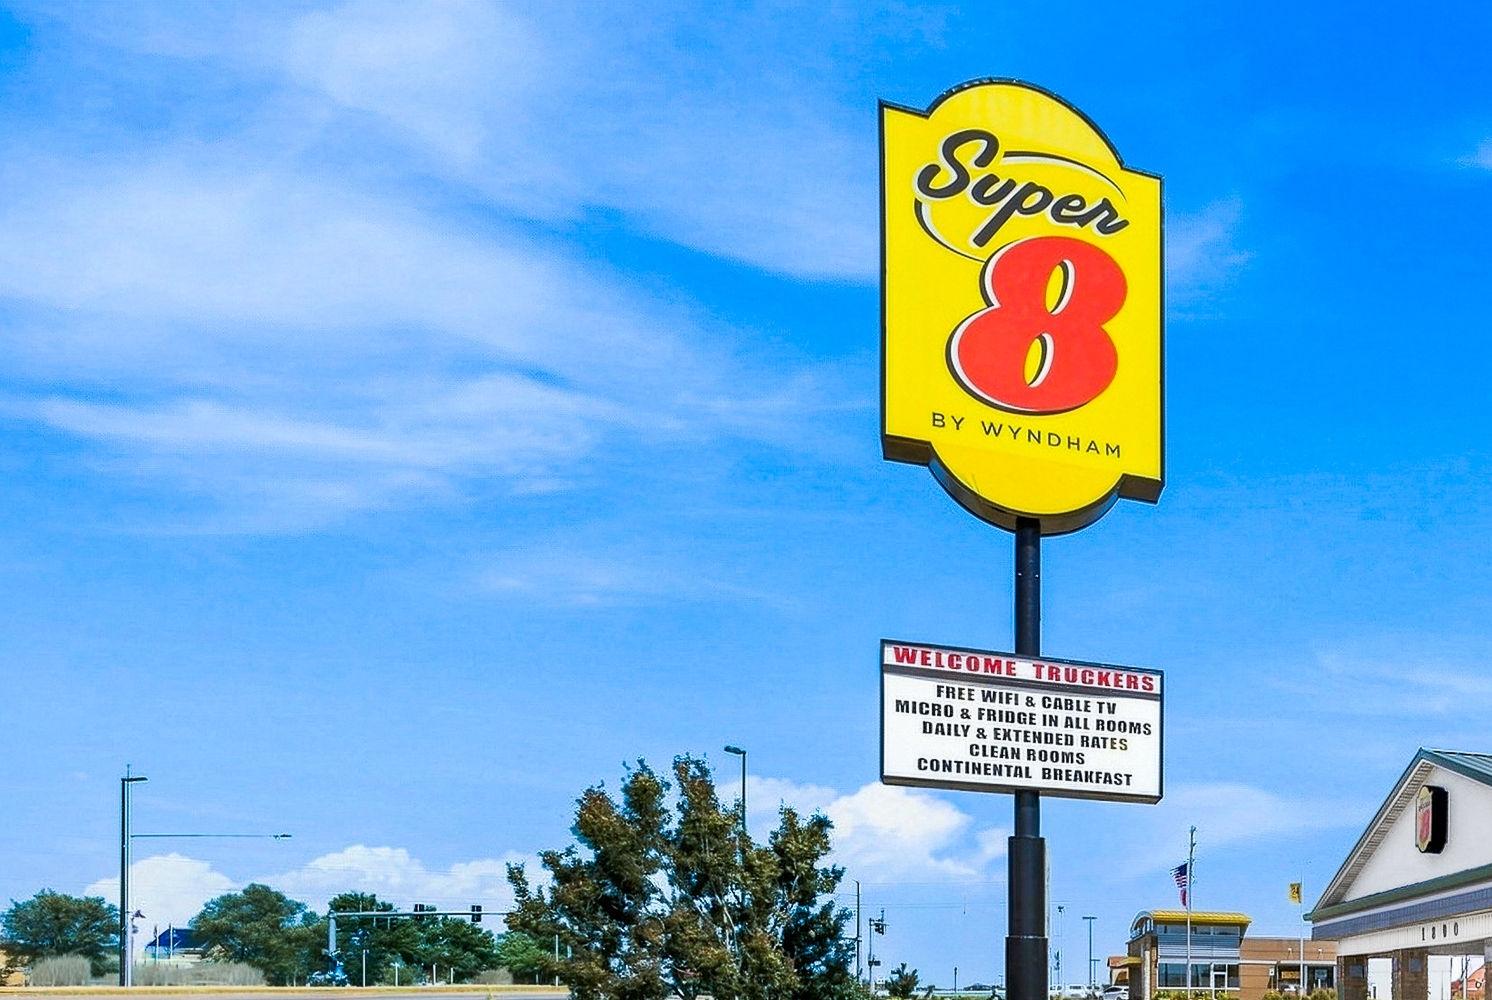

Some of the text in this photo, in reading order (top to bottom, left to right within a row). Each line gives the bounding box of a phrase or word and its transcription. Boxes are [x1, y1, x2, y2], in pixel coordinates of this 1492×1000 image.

[915, 129, 1130, 248] Super
[945, 236, 1128, 416] 8
[931, 412, 1121, 459] BY WYNDHAM
[893, 647, 1154, 691] WELCOME TRUCKERS
[937, 685, 1116, 714] FREE WIFI & CABLE TV
[895, 700, 1152, 735] MICRO & FRIDGE IN ALL ROOMS
[922, 721, 1128, 751] DAILY & EXTENDED RATES
[969, 744, 1085, 765] CLEAN ROOMS
[918, 758, 1132, 786] CONTINENTAL BREAKFAST
[1421, 922, 1459, 941] 1800
